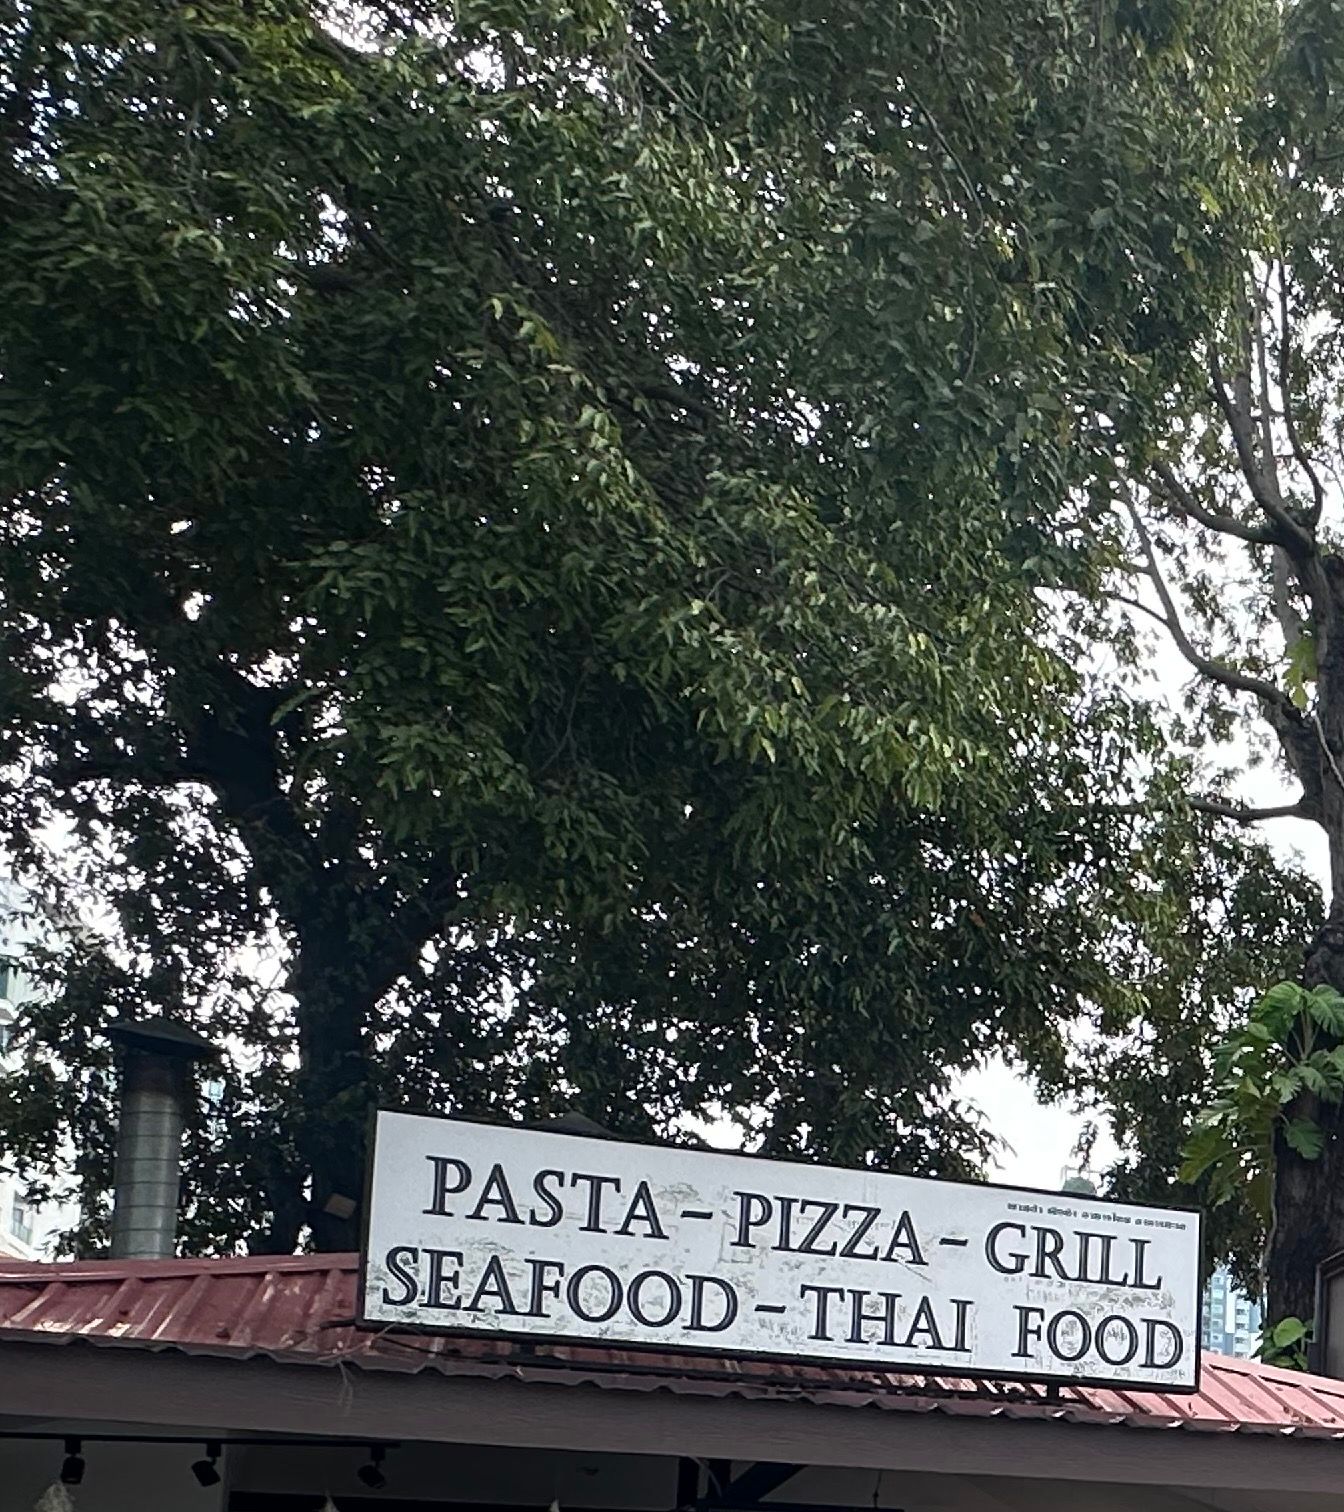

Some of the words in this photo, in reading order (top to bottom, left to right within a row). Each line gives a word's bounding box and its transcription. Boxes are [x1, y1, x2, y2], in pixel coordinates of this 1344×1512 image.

[422, 1154, 669, 1240] PASTA
[730, 1189, 929, 1266] PIZZA
[984, 1220, 1163, 1291] GRILL
[382, 1245, 739, 1333] SEAFOOD
[800, 1283, 973, 1354] THAI
[1011, 1303, 1185, 1371] FOOD
